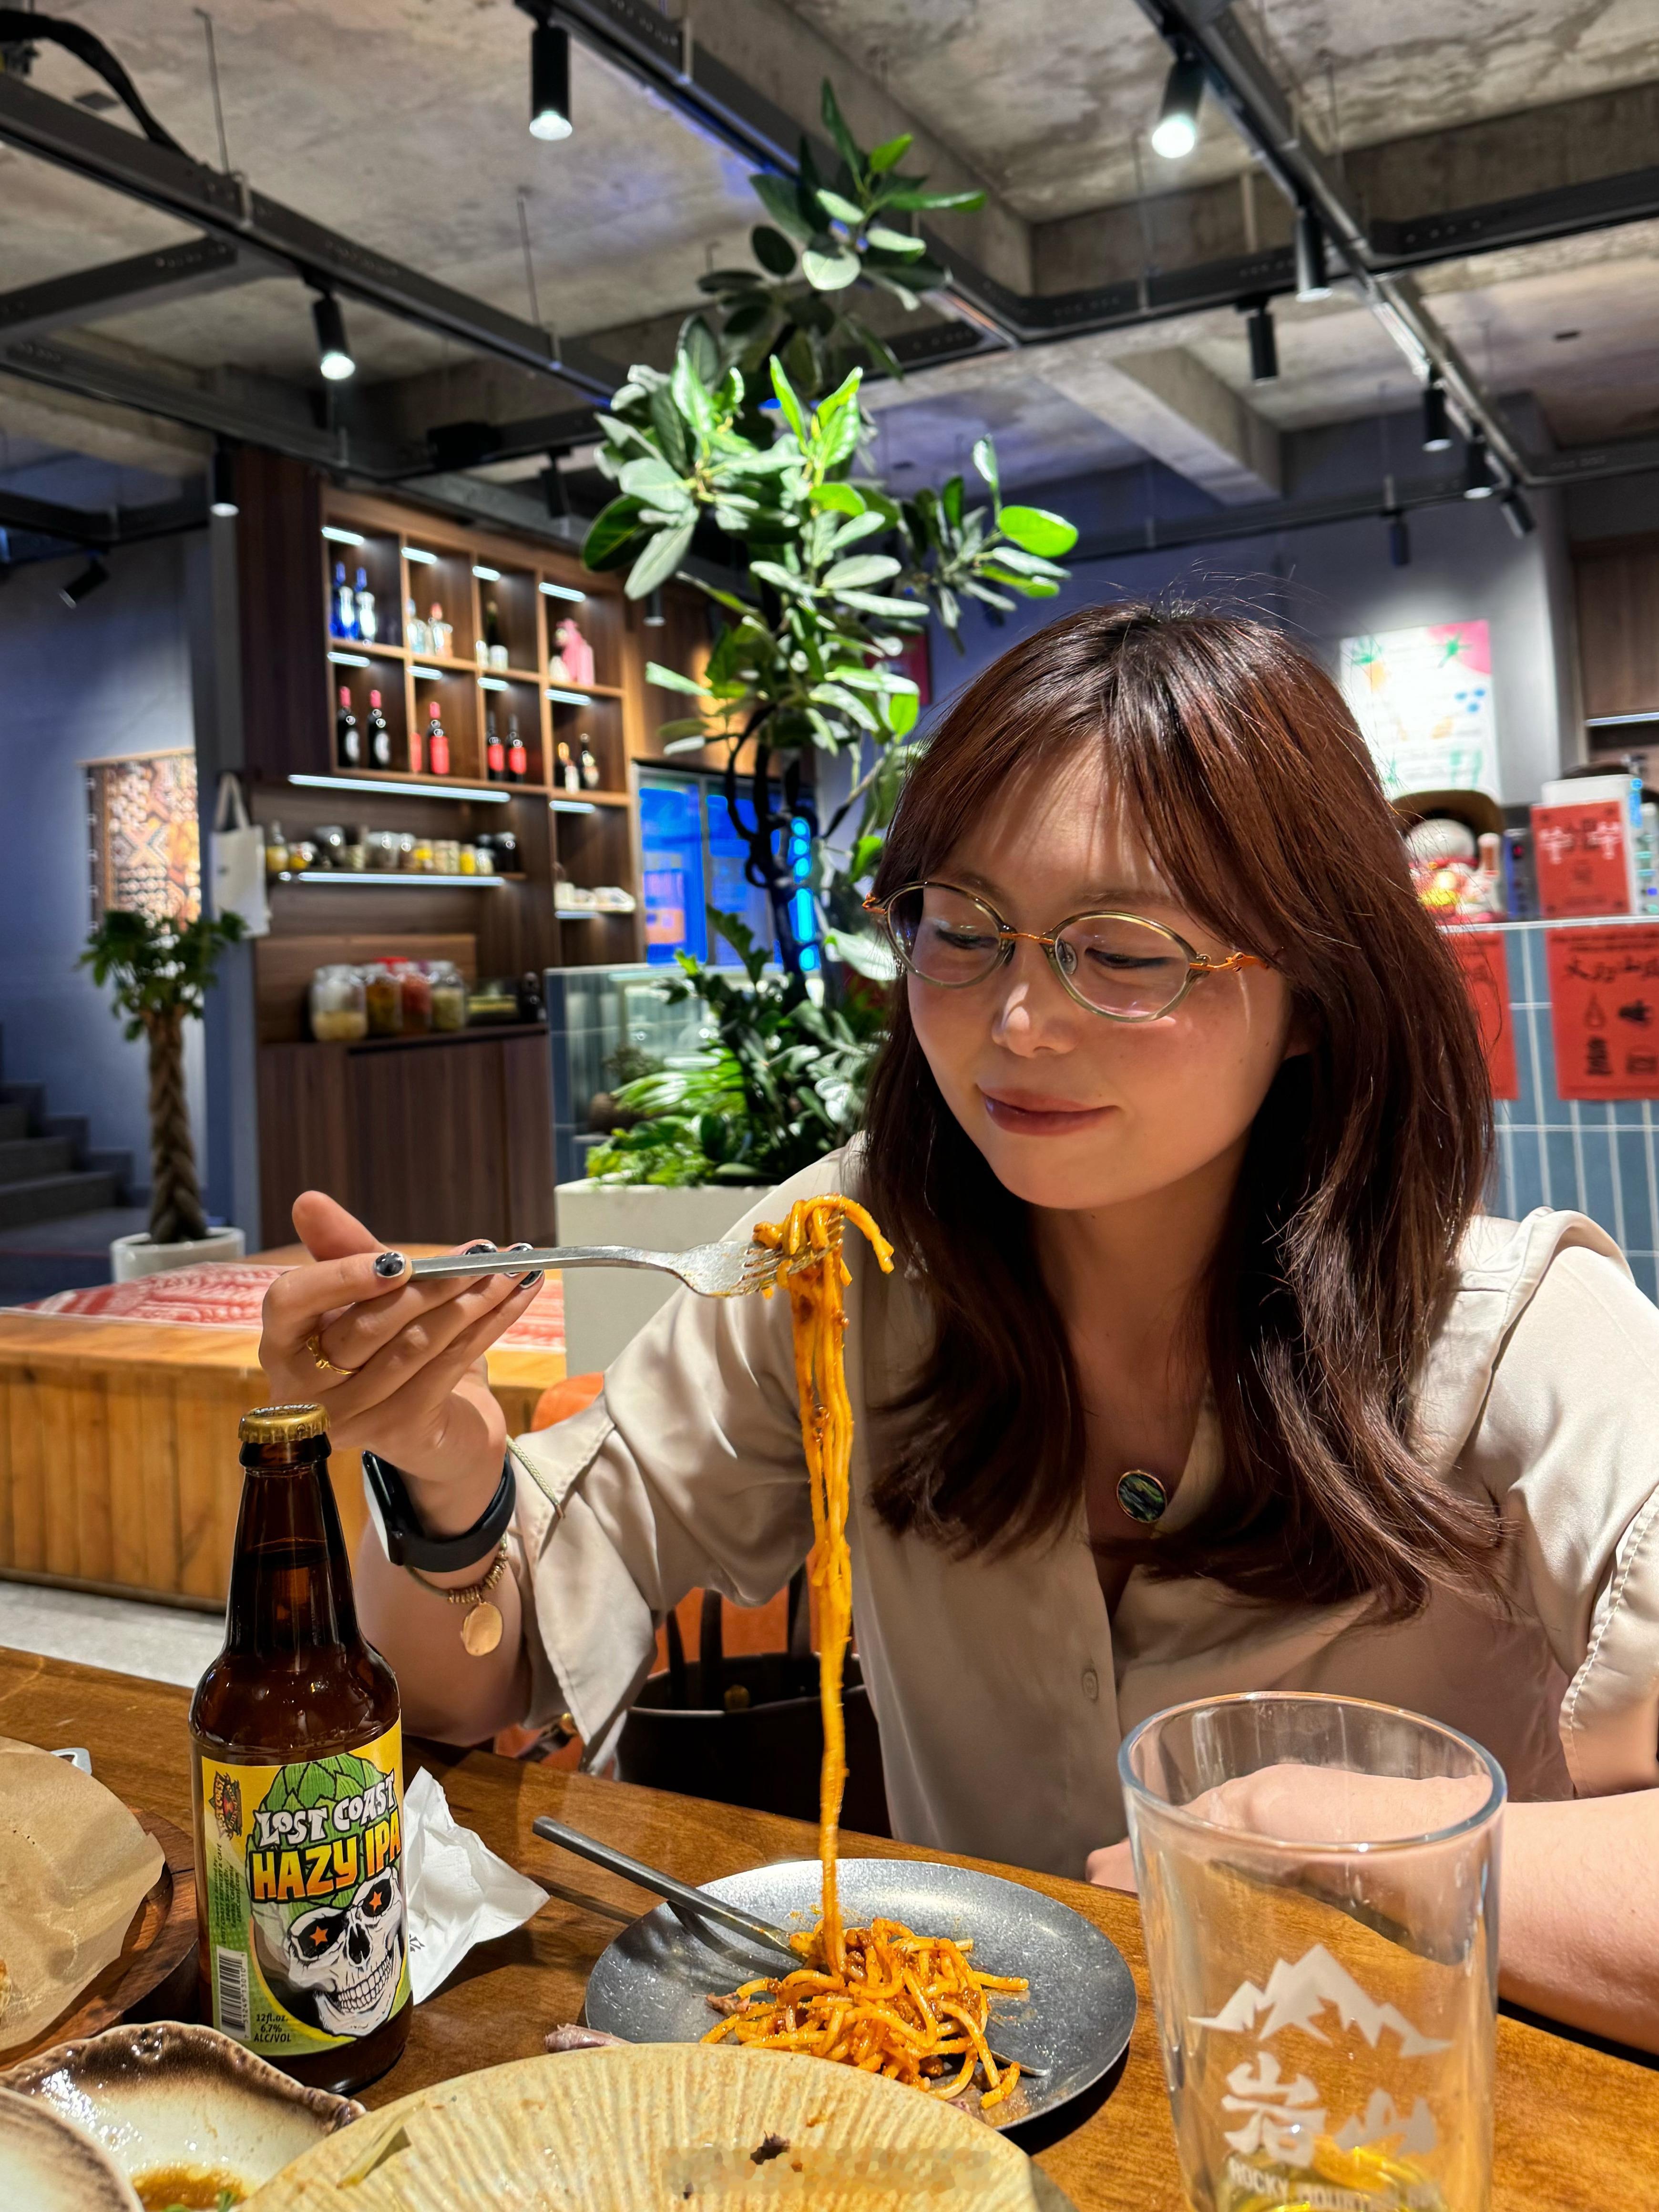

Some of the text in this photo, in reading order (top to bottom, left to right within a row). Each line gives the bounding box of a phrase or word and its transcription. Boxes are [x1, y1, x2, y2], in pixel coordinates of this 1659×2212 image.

[215, 1776, 225, 1806] COAST
[254, 1807, 328, 1847] LOST
[333, 1768, 395, 1831] COAST
[252, 1810, 401, 1900] HAZY IPA
[254, 2033, 291, 2043] ALC/VOL
[260, 2024, 282, 2033] 6.7%
